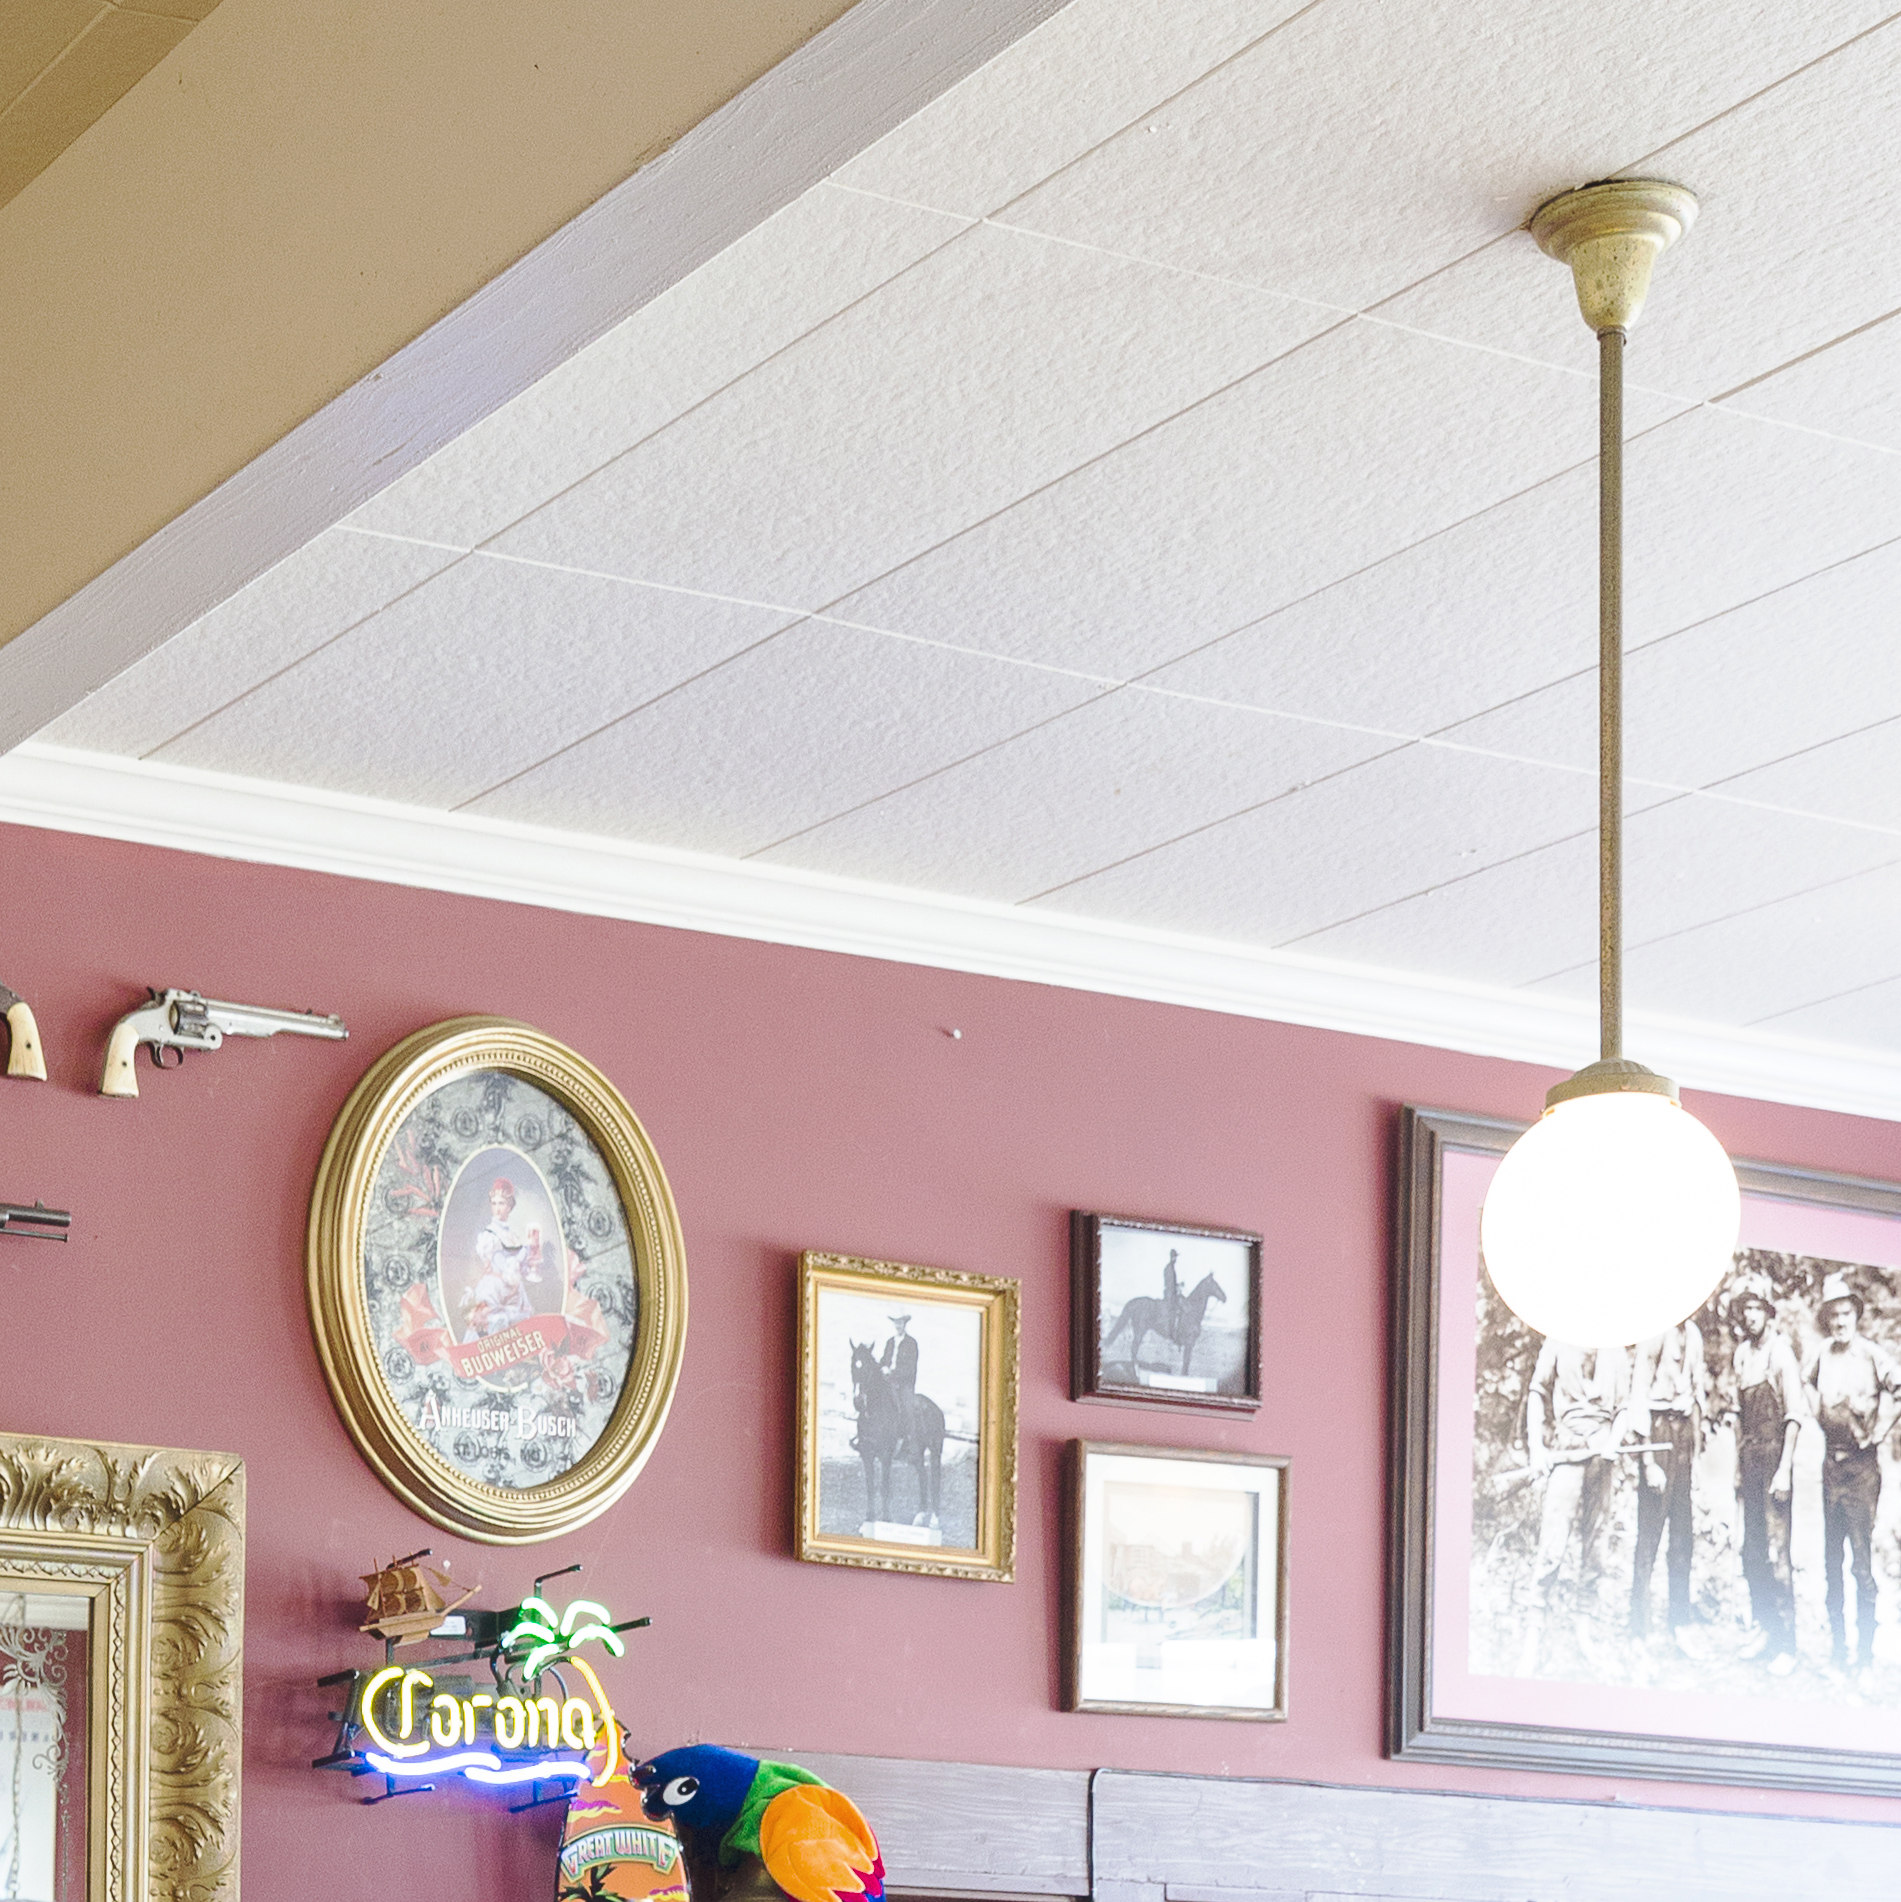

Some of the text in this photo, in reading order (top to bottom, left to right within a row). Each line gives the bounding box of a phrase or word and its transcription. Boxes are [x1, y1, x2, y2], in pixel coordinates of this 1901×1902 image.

[460, 1330, 546, 1377] BUDWEISER
[477, 1326, 522, 1351] ORIGINAL
[362, 1666, 598, 1758] Corona
[561, 1830, 677, 1876] GREAT WHITE
